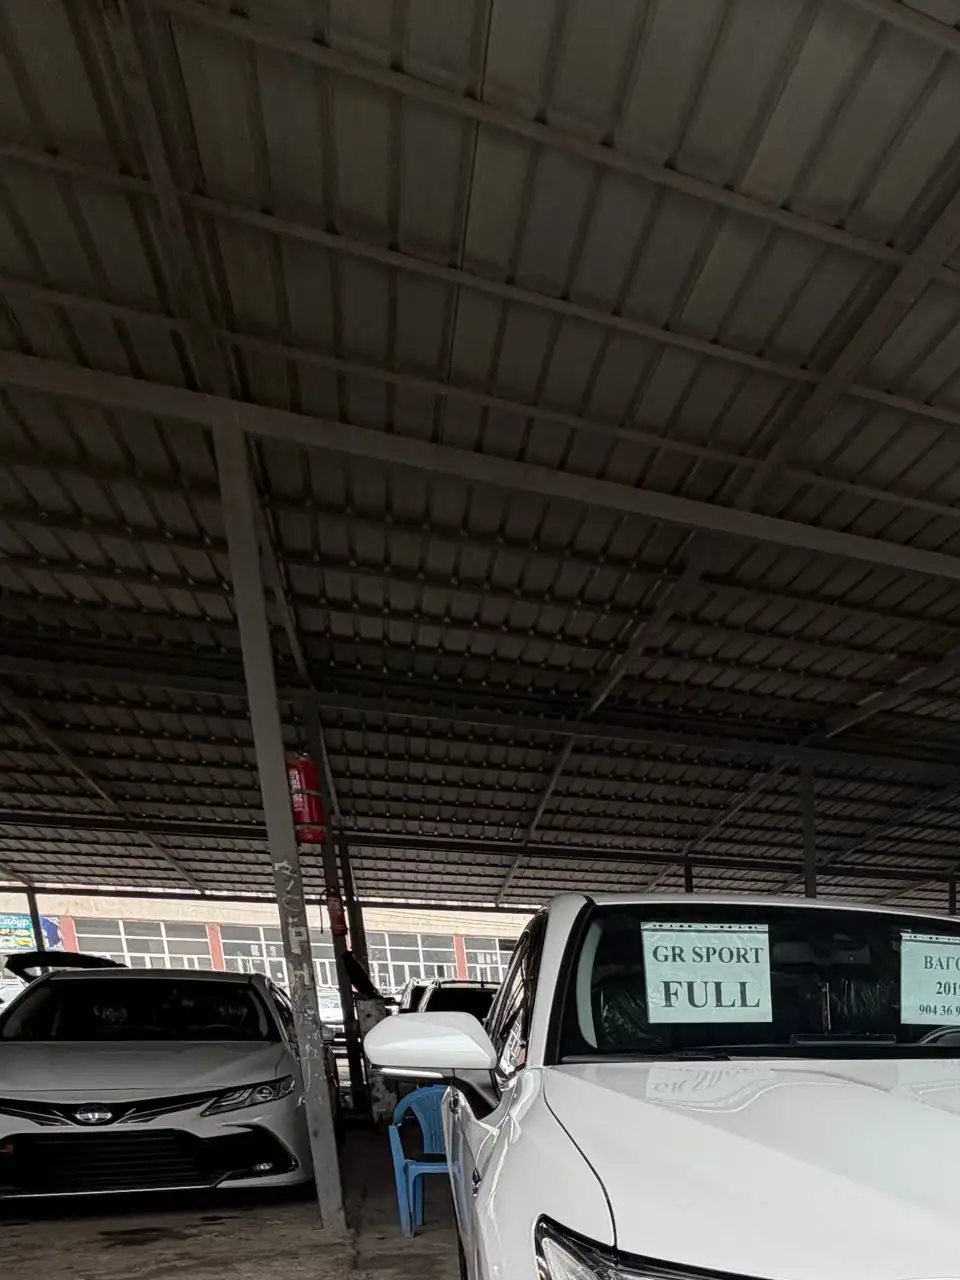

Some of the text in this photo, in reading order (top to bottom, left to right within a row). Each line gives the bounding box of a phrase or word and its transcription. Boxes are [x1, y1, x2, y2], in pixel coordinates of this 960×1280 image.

[652, 945, 764, 964] GR SPORT
[660, 980, 761, 1009] FULL
[919, 1004, 938, 1016] 904
[940, 1005, 953, 1017] 36
